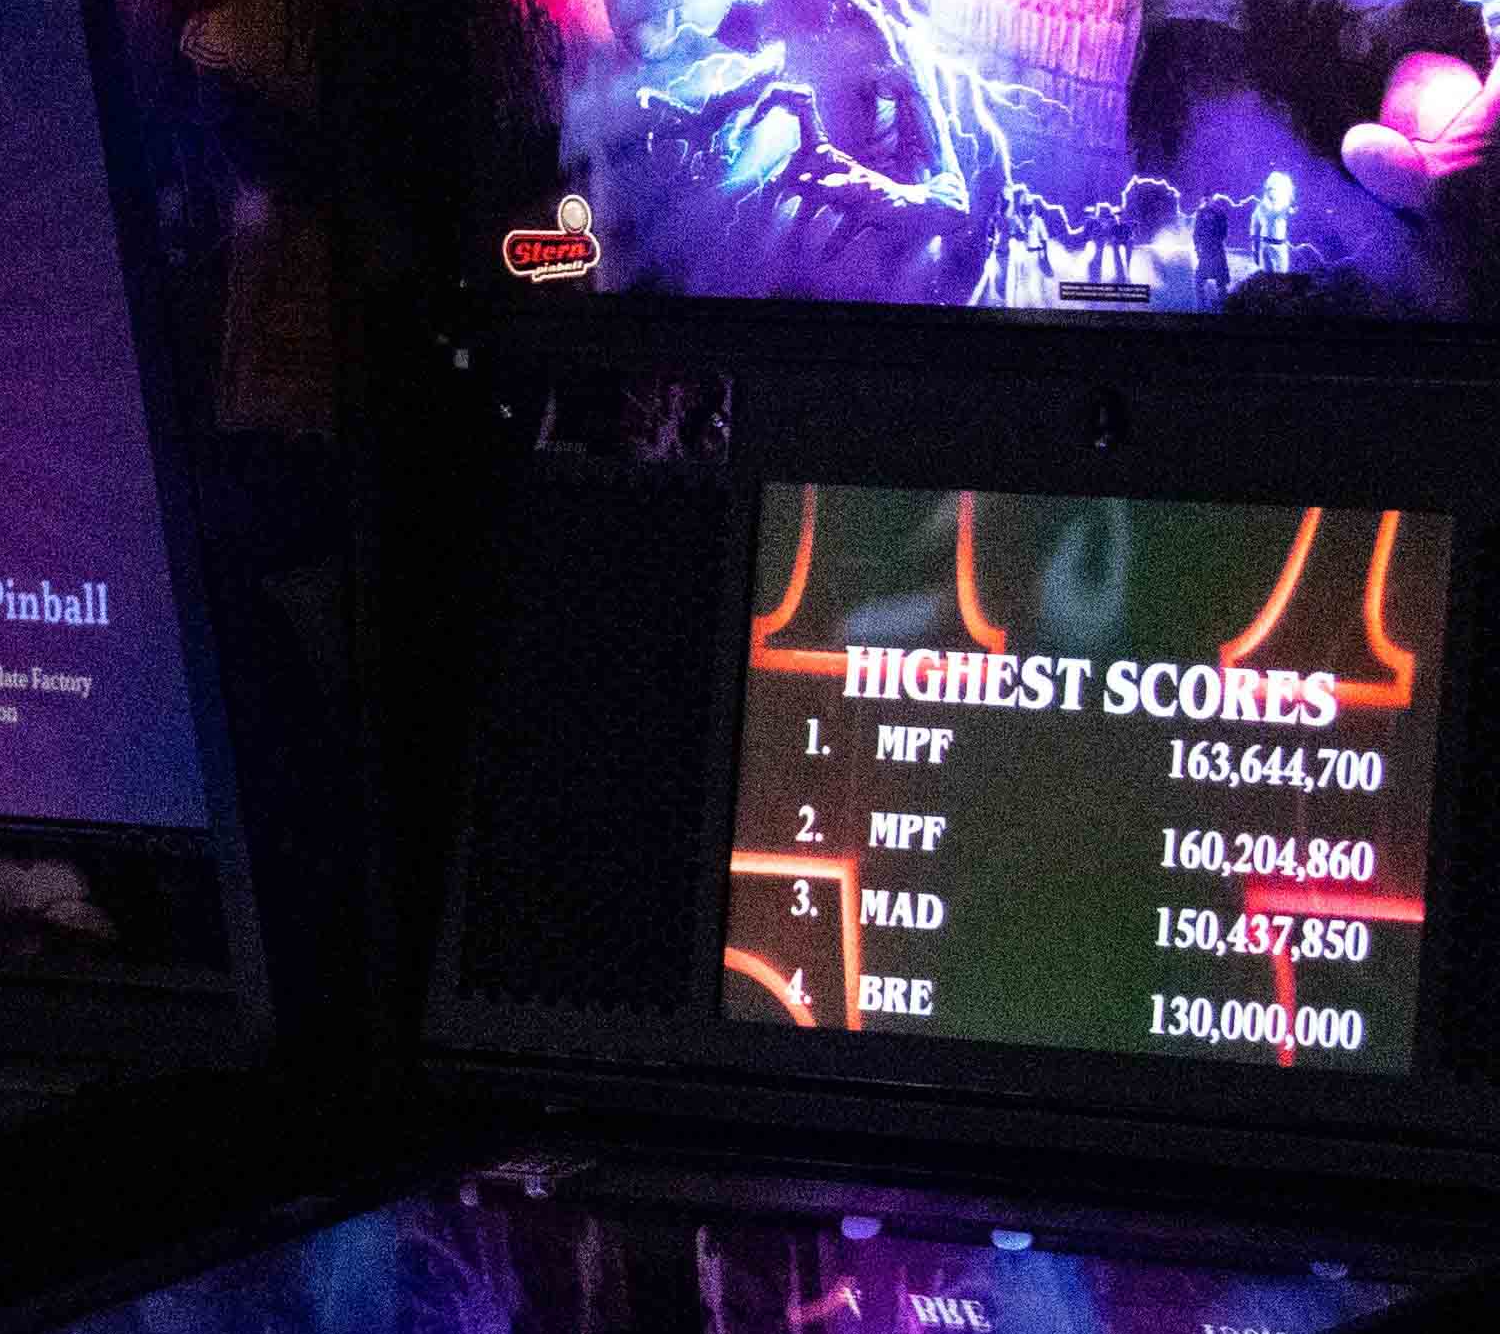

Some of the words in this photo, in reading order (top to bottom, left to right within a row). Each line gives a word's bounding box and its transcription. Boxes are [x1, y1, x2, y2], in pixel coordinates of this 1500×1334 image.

[513, 241, 590, 264] Stern
[30, 665, 93, 700] Factory
[842, 643, 1091, 712] HIGHEST
[1104, 656, 1339, 726] SCORES
[805, 719, 831, 757] 1.
[877, 723, 954, 765] MPF
[1169, 739, 1384, 793] 163,644,700
[797, 805, 824, 844] 2.
[869, 810, 947, 854] MPF
[1160, 828, 1376, 882] 160,204,860
[789, 880, 819, 918] 3.
[860, 889, 945, 930] MAD
[1155, 906, 1369, 963] 150,437,850
[858, 973, 933, 1016] BRE
[1149, 994, 1363, 1052] 130,000,000
